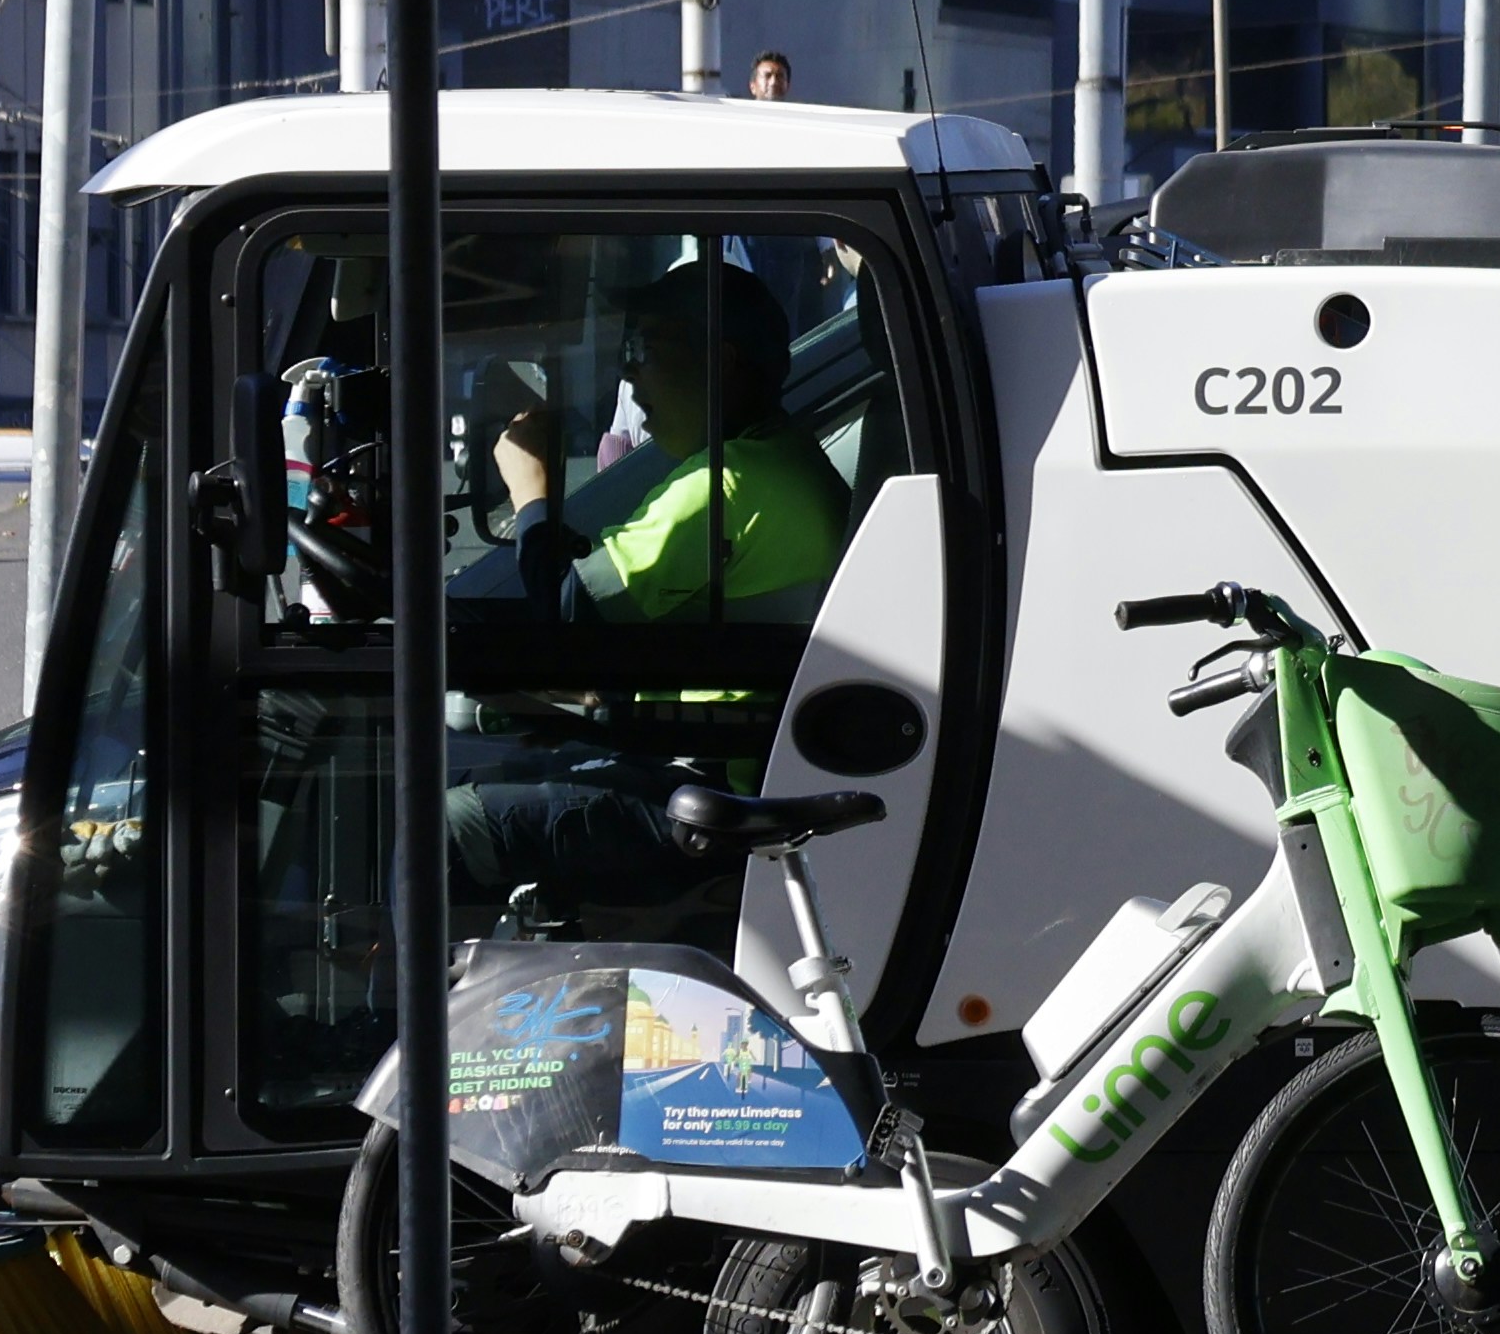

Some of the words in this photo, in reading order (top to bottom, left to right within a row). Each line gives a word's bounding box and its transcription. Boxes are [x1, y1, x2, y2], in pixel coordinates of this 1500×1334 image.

[1195, 367, 1342, 415] C202
[451, 1051, 487, 1065] FILL
[450, 1063, 521, 1080] BASKET
[524, 1060, 564, 1074] AND
[1048, 990, 1232, 1164] Lime
[449, 1081, 485, 1095] GET
[489, 1076, 553, 1091] RIDING
[663, 1106, 686, 1121] Try
[687, 1105, 709, 1118] the
[710, 1107, 738, 1118] new
[740, 1106, 803, 1119] LimePass
[662, 1119, 682, 1131] for
[683, 1119, 713, 1134] only
[752, 1122, 761, 1131] a
[763, 1120, 789, 1134] day
